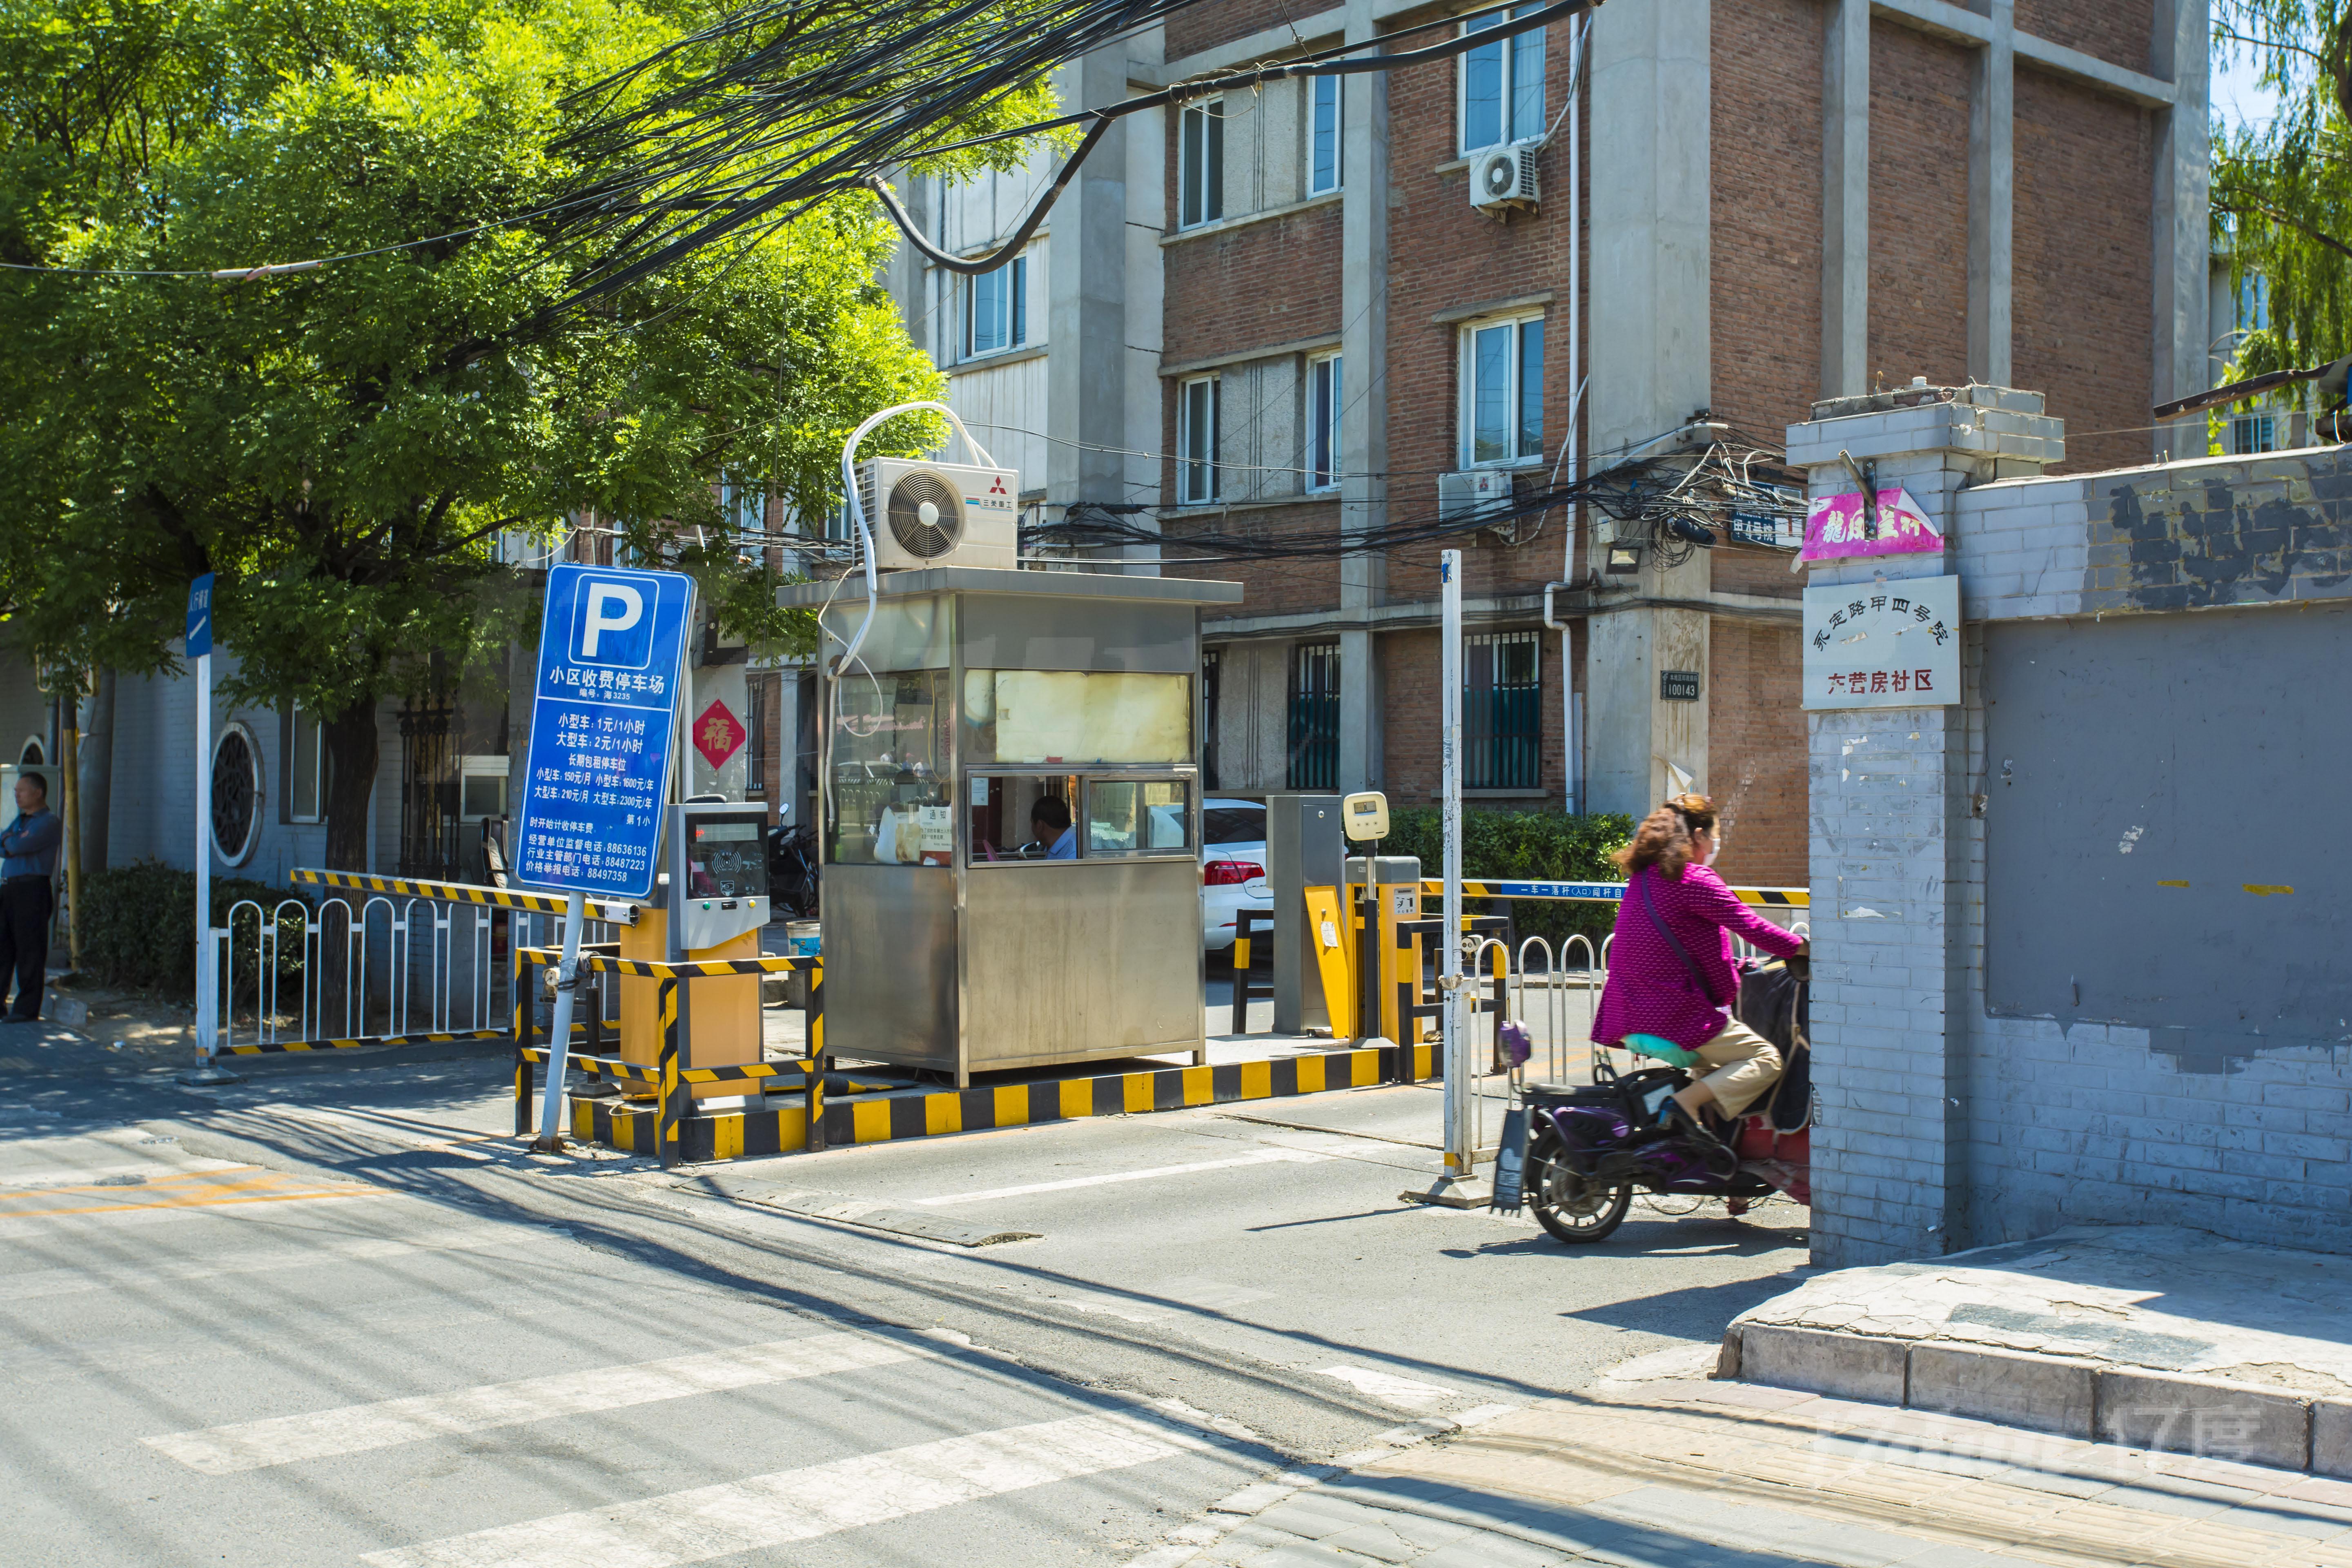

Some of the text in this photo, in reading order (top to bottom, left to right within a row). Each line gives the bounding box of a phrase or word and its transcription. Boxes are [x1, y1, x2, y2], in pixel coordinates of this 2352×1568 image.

[983, 500, 1012, 508] 三菱重工
[1813, 595, 1949, 652] 永定路甲四号院
[549, 665, 665, 695] 小区收费停车场
[1669, 684, 1695, 696] 100143
[702, 717, 735, 753] 福
[568, 753, 626, 772] 长期包租停车位
[929, 810, 947, 820] 通知
[1521, 884, 1570, 896] 一车一落杆
